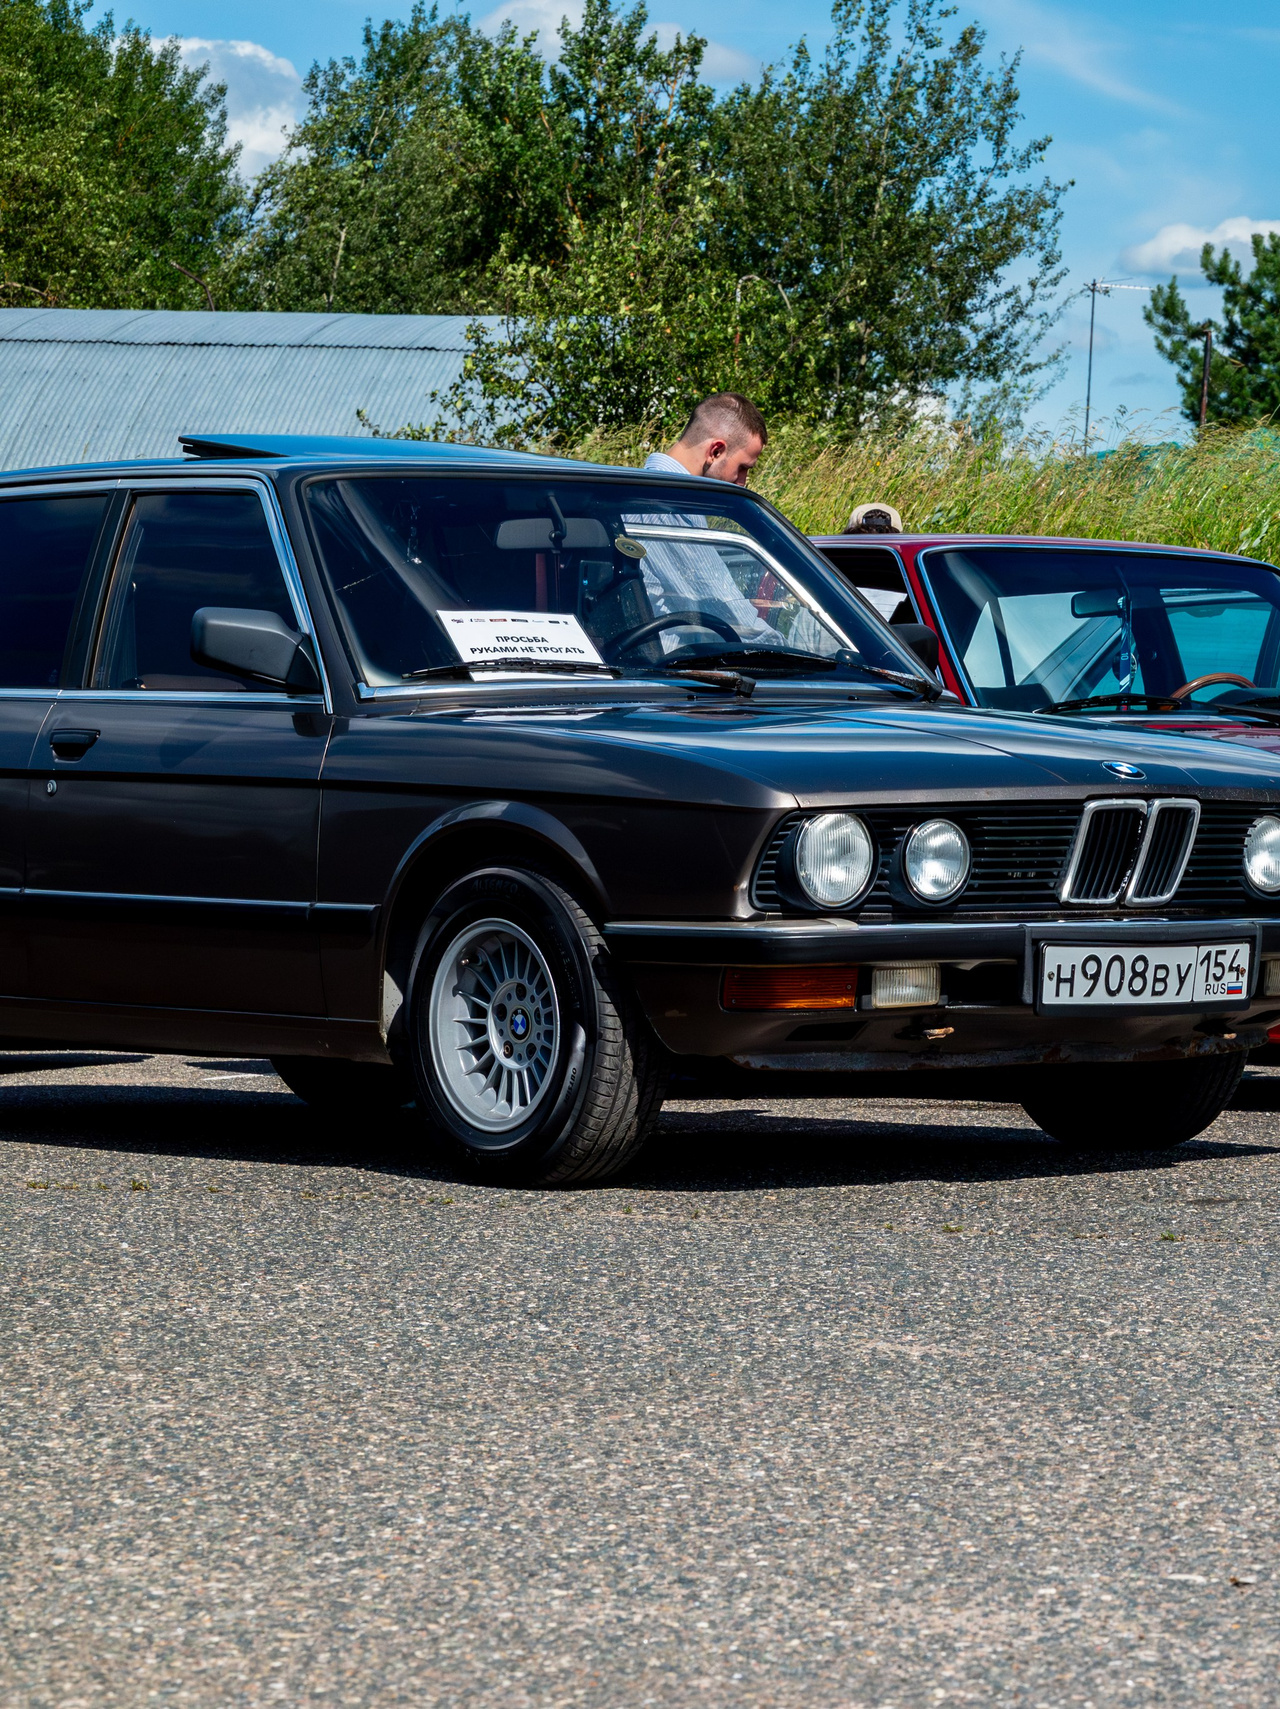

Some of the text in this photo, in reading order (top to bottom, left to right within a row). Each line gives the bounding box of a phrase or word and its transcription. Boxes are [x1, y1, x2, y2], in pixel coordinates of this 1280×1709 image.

[495, 635, 549, 644] ПРОСЬБА
[470, 646, 585, 655] РУКАМИ НЕ ТРОГАТЬ
[1199, 948, 1241, 982] 154
[1204, 983, 1226, 995] RUS
